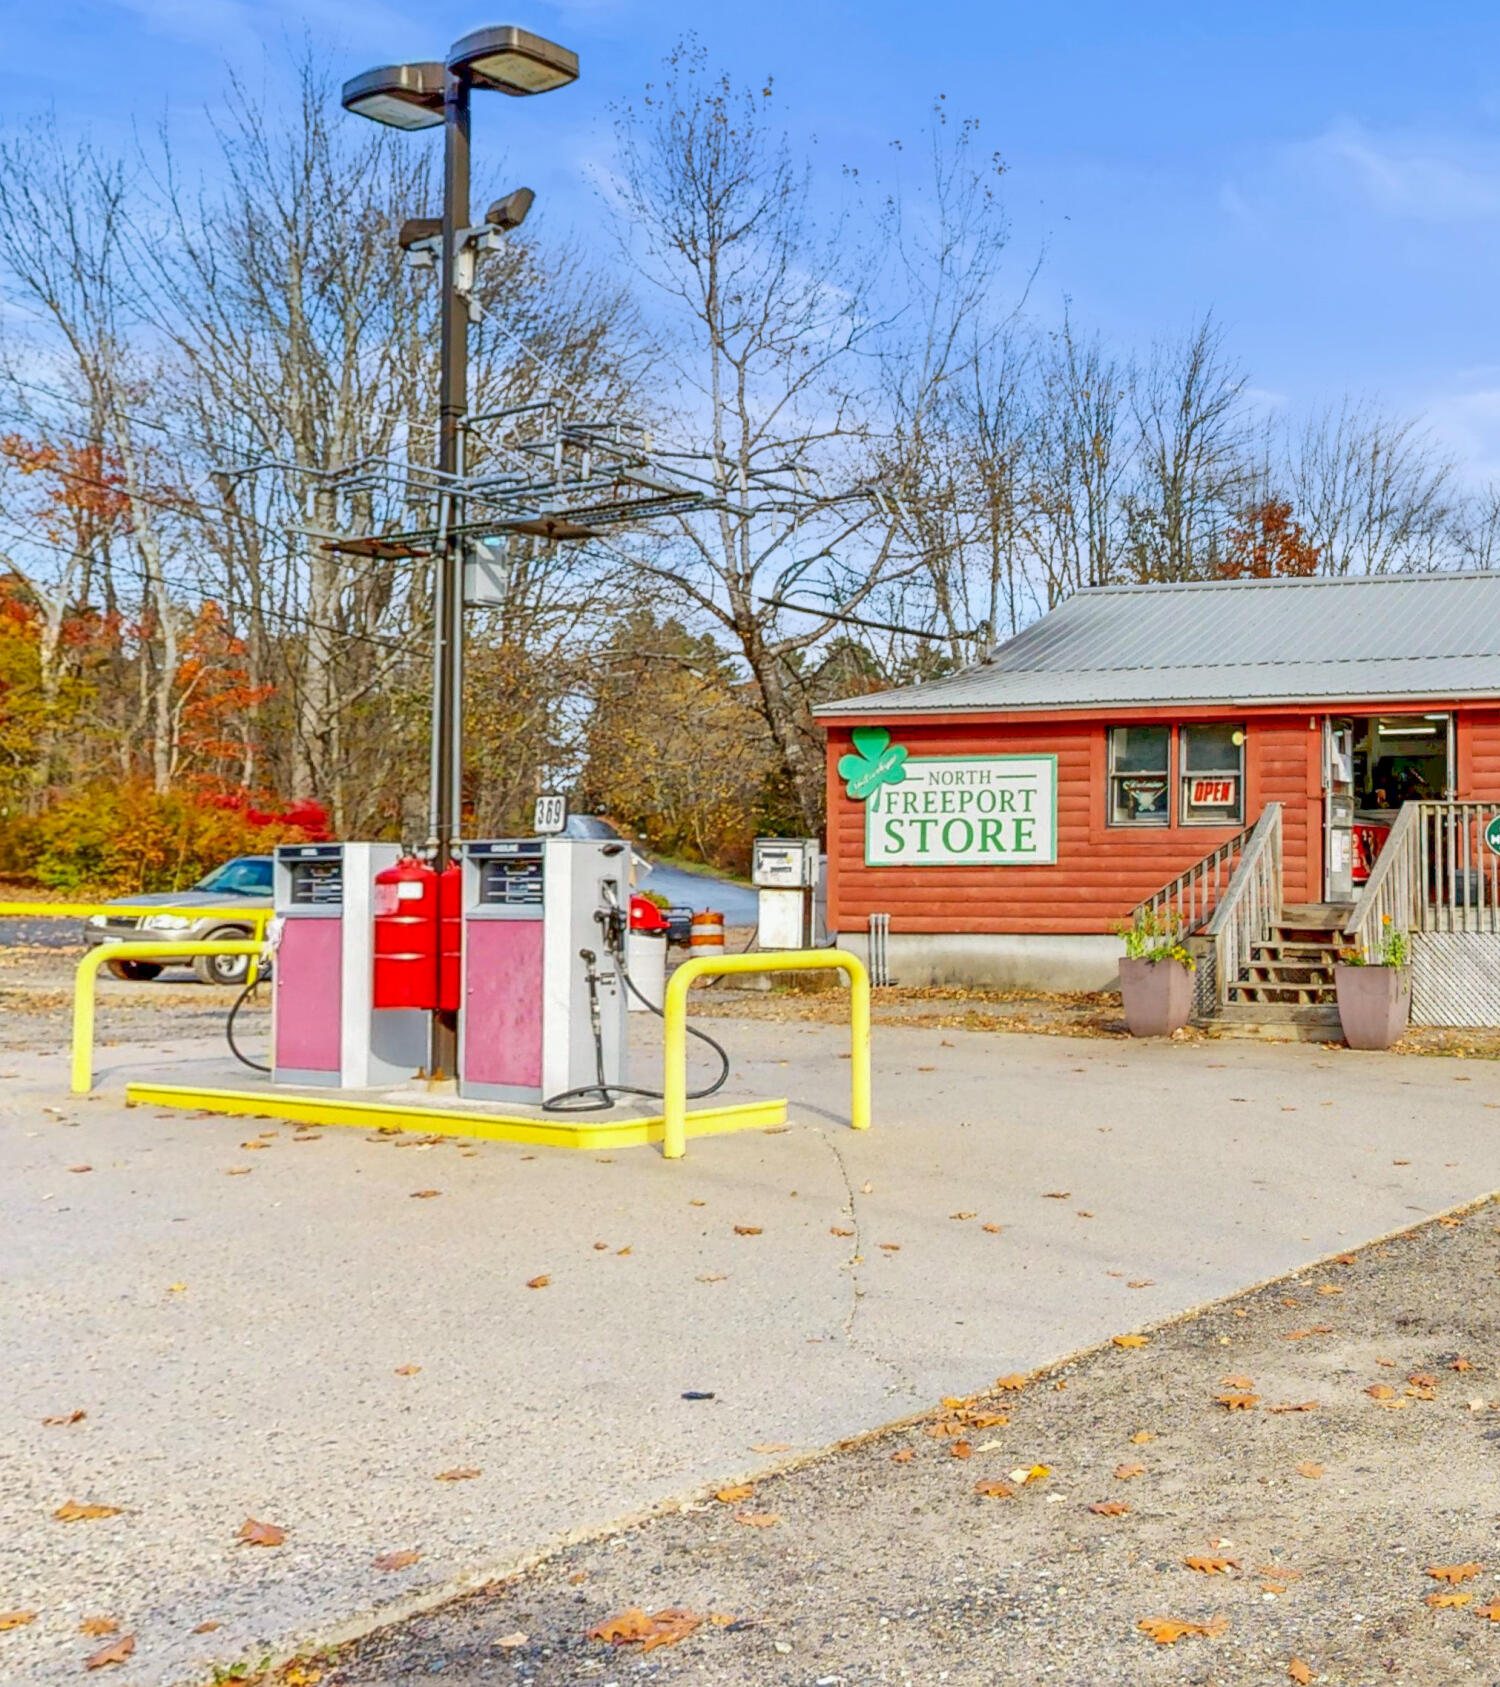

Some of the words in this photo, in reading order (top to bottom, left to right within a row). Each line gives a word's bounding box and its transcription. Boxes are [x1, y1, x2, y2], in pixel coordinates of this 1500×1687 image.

[928, 769, 992, 786] NORTH
[885, 789, 1038, 815] FREEPORT
[1194, 781, 1231, 802] OPEN
[537, 799, 561, 825] 369
[884, 818, 1037, 854] STORE
